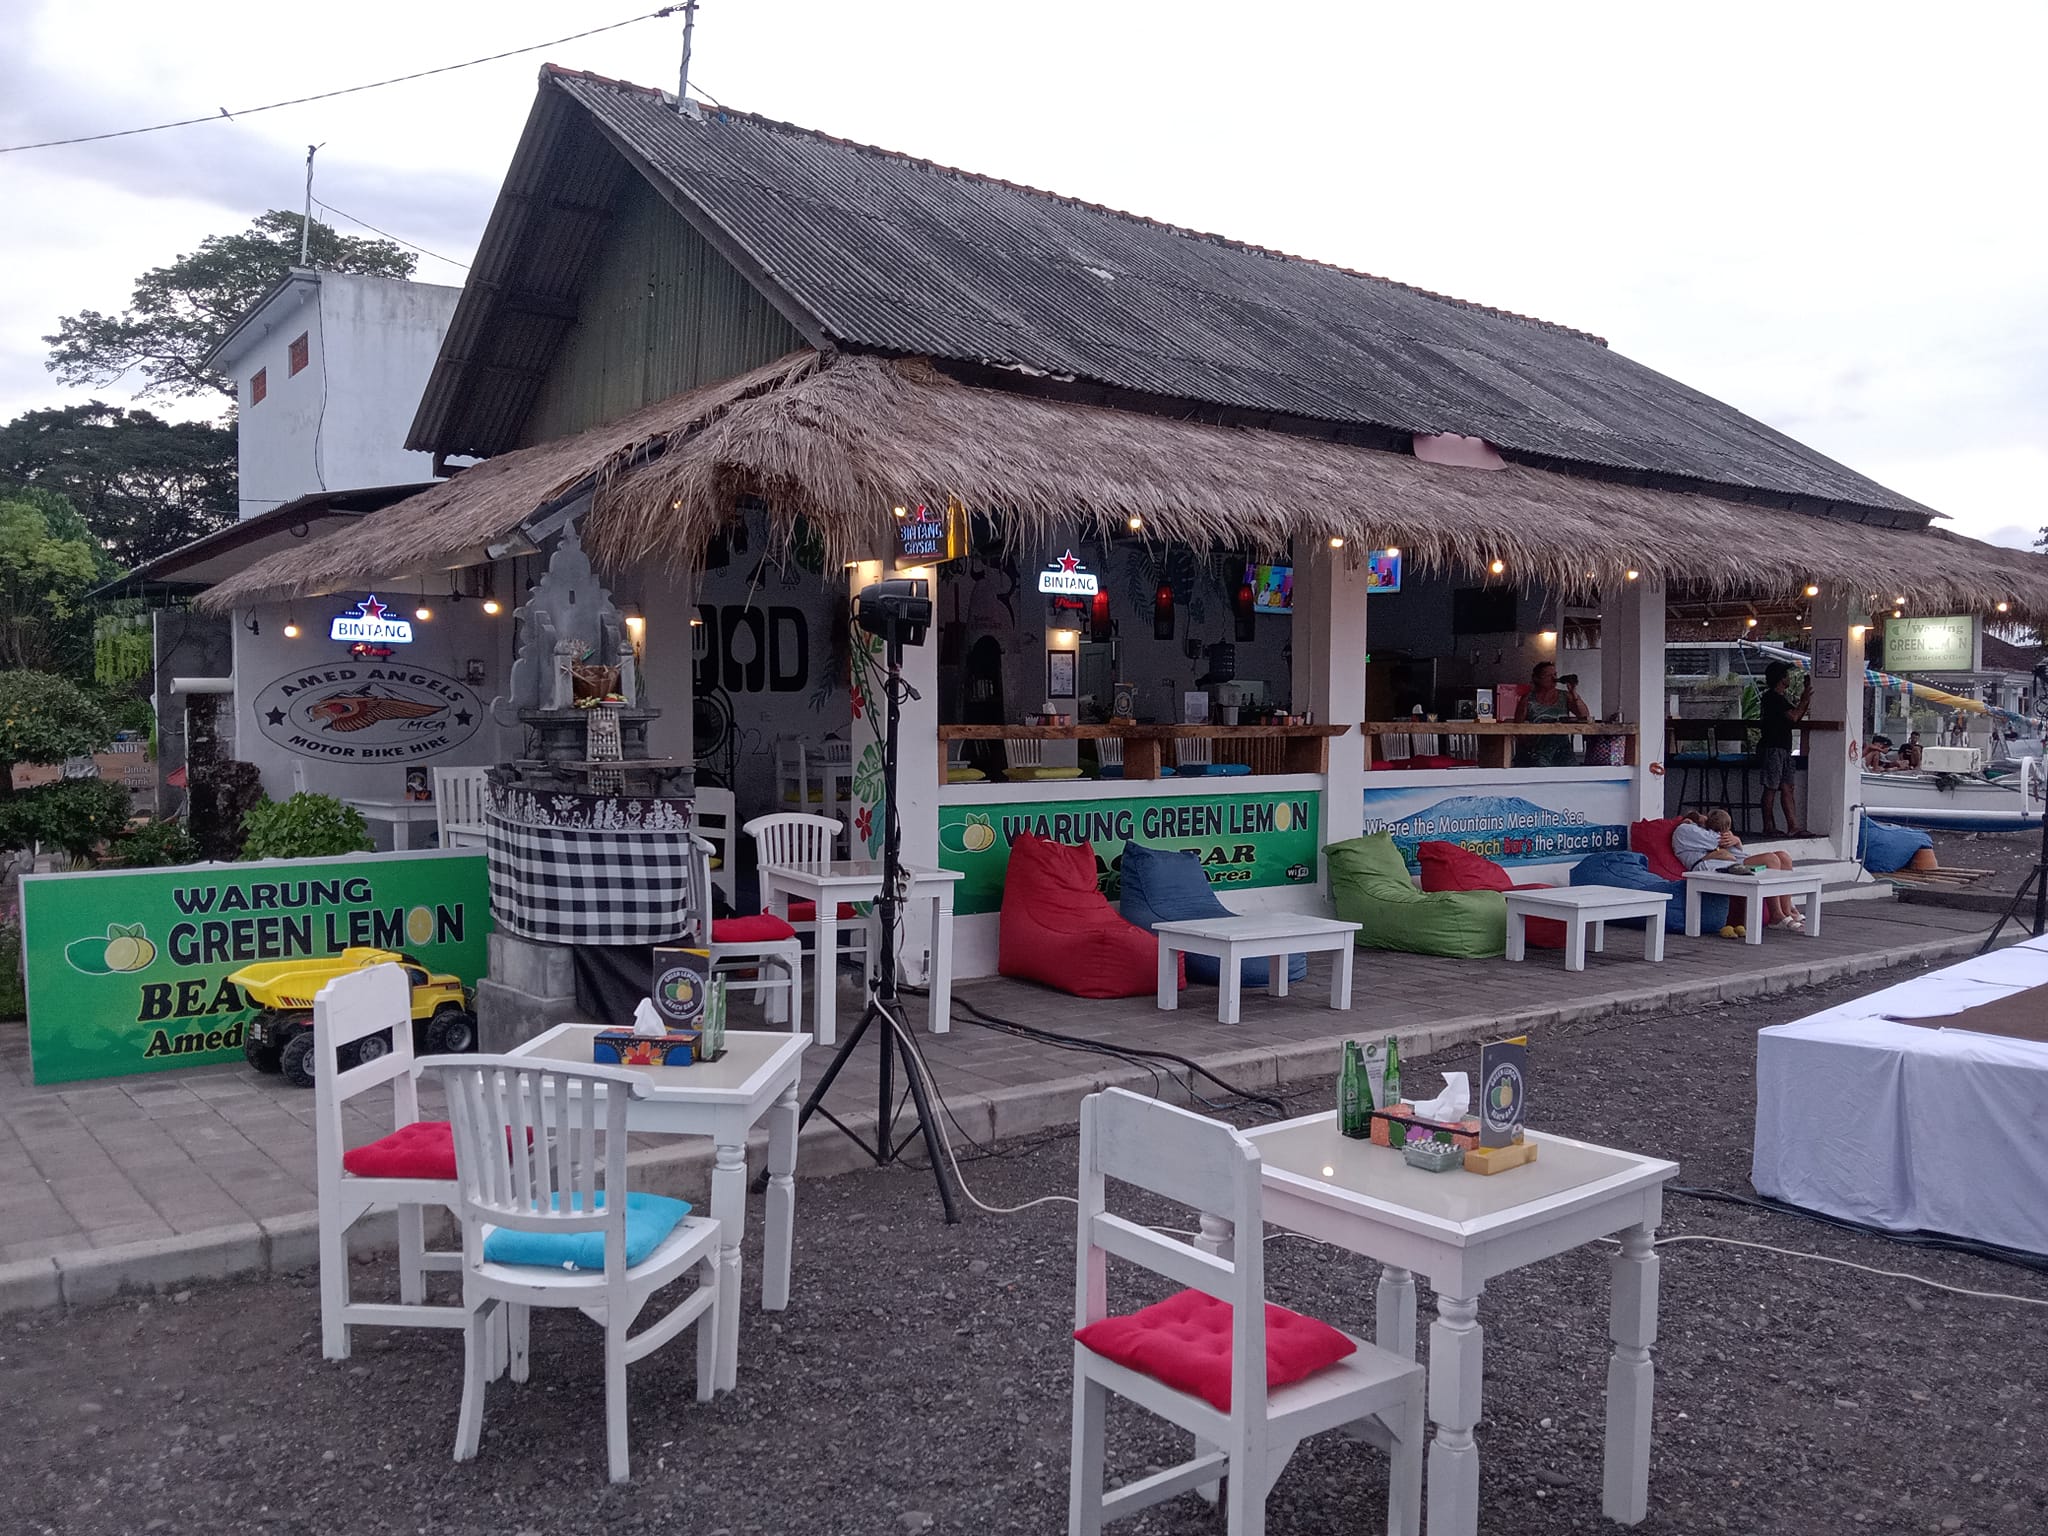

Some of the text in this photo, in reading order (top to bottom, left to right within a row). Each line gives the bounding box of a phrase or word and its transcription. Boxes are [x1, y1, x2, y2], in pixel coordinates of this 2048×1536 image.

[900, 522, 943, 541] BINTANG
[1044, 575, 1095, 591] BINTANG
[338, 622, 407, 638] BINTANG
[691, 604, 809, 693] OOD
[1889, 638, 1925, 652] GREEN
[281, 669, 465, 702] AMED ANGELS
[406, 719, 447, 731] MCA
[288, 734, 450, 759] MOTOR BIKE HIRE
[1002, 809, 1134, 848] WARUNG
[1142, 804, 1222, 840] GREEN
[1365, 817, 1410, 836] Where
[1413, 816, 1434, 834] the
[1439, 812, 1504, 833] Mountains
[1507, 810, 1538, 830] Meet
[1541, 808, 1559, 826] the
[1460, 838, 1500, 856] Beach
[1535, 833, 1554, 851] the
[1557, 831, 1589, 849] Place
[1591, 831, 1602, 847] to
[1605, 829, 1620, 846] Be
[172, 877, 373, 916] WARUNG
[167, 913, 313, 967] GREEN
[143, 1021, 244, 1058] Amed
